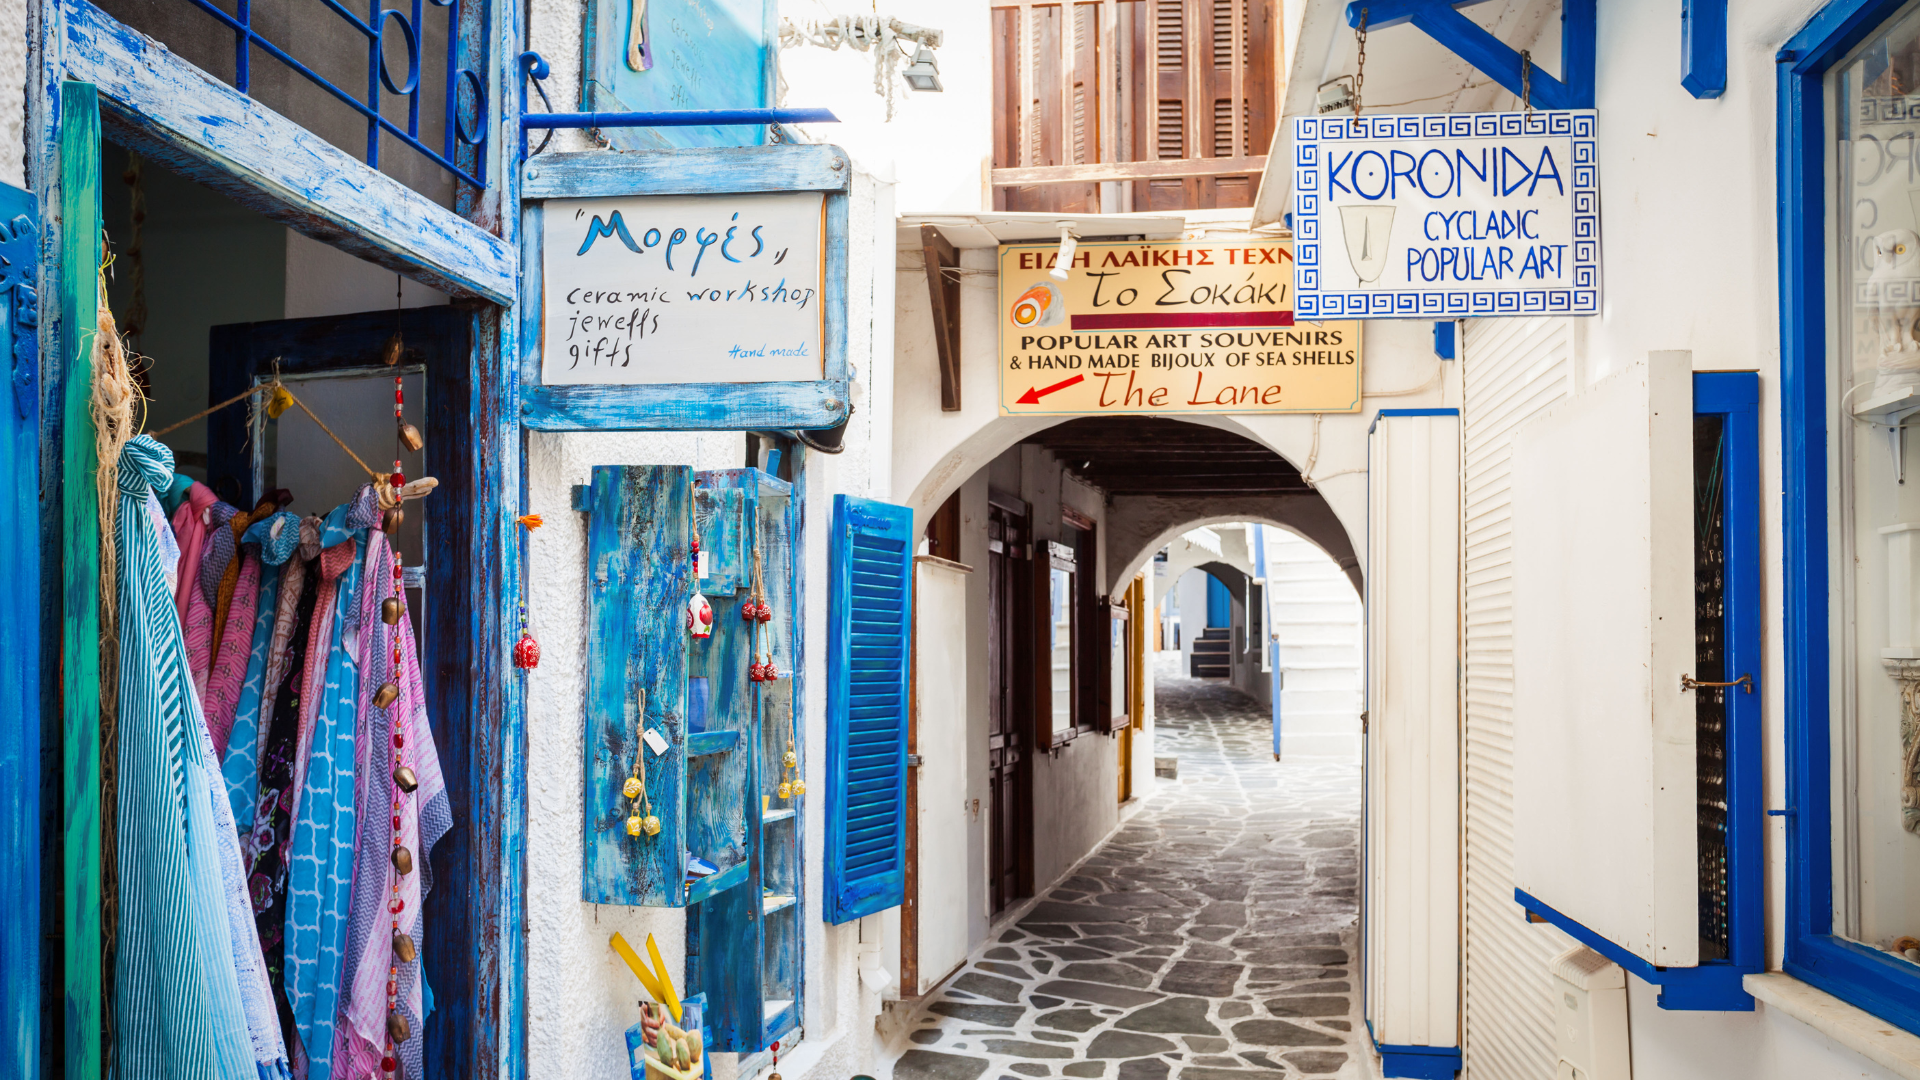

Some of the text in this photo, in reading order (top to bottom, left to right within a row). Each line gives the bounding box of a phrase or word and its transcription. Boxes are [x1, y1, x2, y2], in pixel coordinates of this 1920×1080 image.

[1328, 145, 1564, 201] KORONIDA
[1423, 208, 1539, 241] CYCLADIC
[1407, 244, 1568, 282] POPULAR ART
[566, 277, 815, 311] ceramic workshop
[1154, 268, 1287, 307] Σοκάκι
[568, 336, 633, 371] gifts
[769, 340, 810, 357] made
[1021, 330, 1343, 351] POPULAR ART SOUVENIRS
[1009, 349, 1355, 372] & HAND MADE BIJOUX OF SEA SHELLS
[1093, 370, 1282, 408] The Lane
